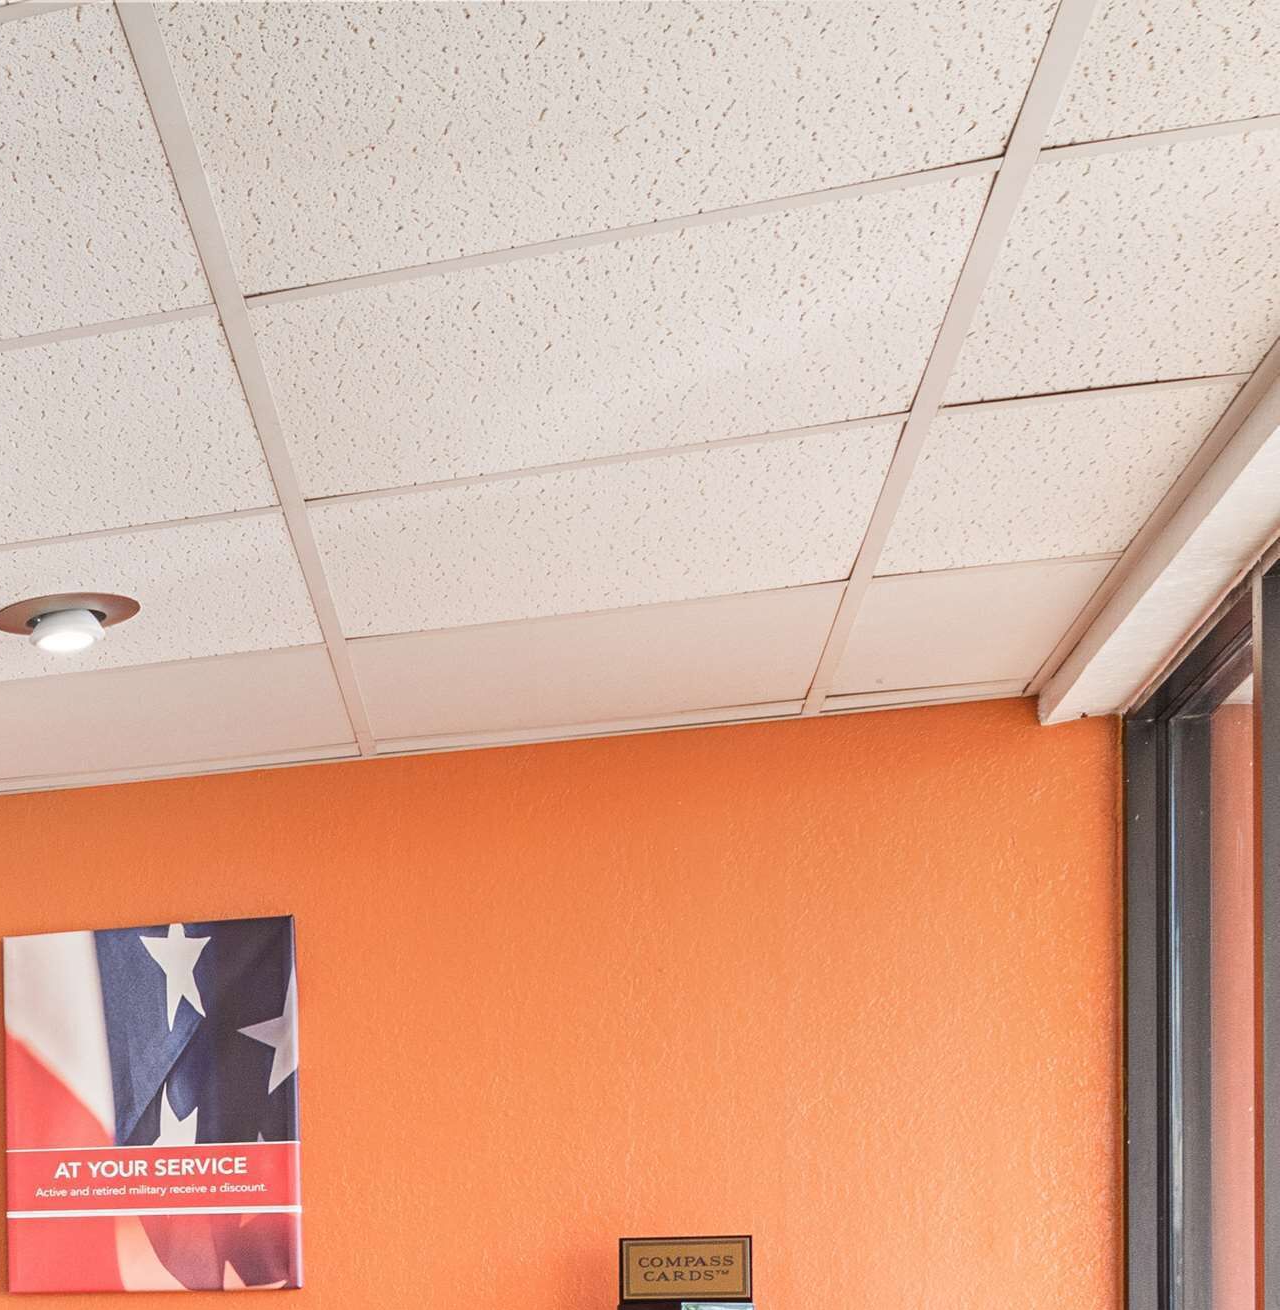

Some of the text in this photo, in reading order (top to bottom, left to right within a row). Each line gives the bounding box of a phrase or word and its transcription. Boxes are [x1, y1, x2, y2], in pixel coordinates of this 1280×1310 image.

[54, 1157, 248, 1179] AT YOUR SERVICE
[35, 1188, 67, 1198] Active
[70, 1187, 89, 1196] and
[92, 1186, 126, 1196] retired
[129, 1185, 167, 1197] military
[169, 1185, 207, 1194] receive
[219, 1183, 267, 1193] discount.
[638, 1255, 734, 1268] COMPASS
